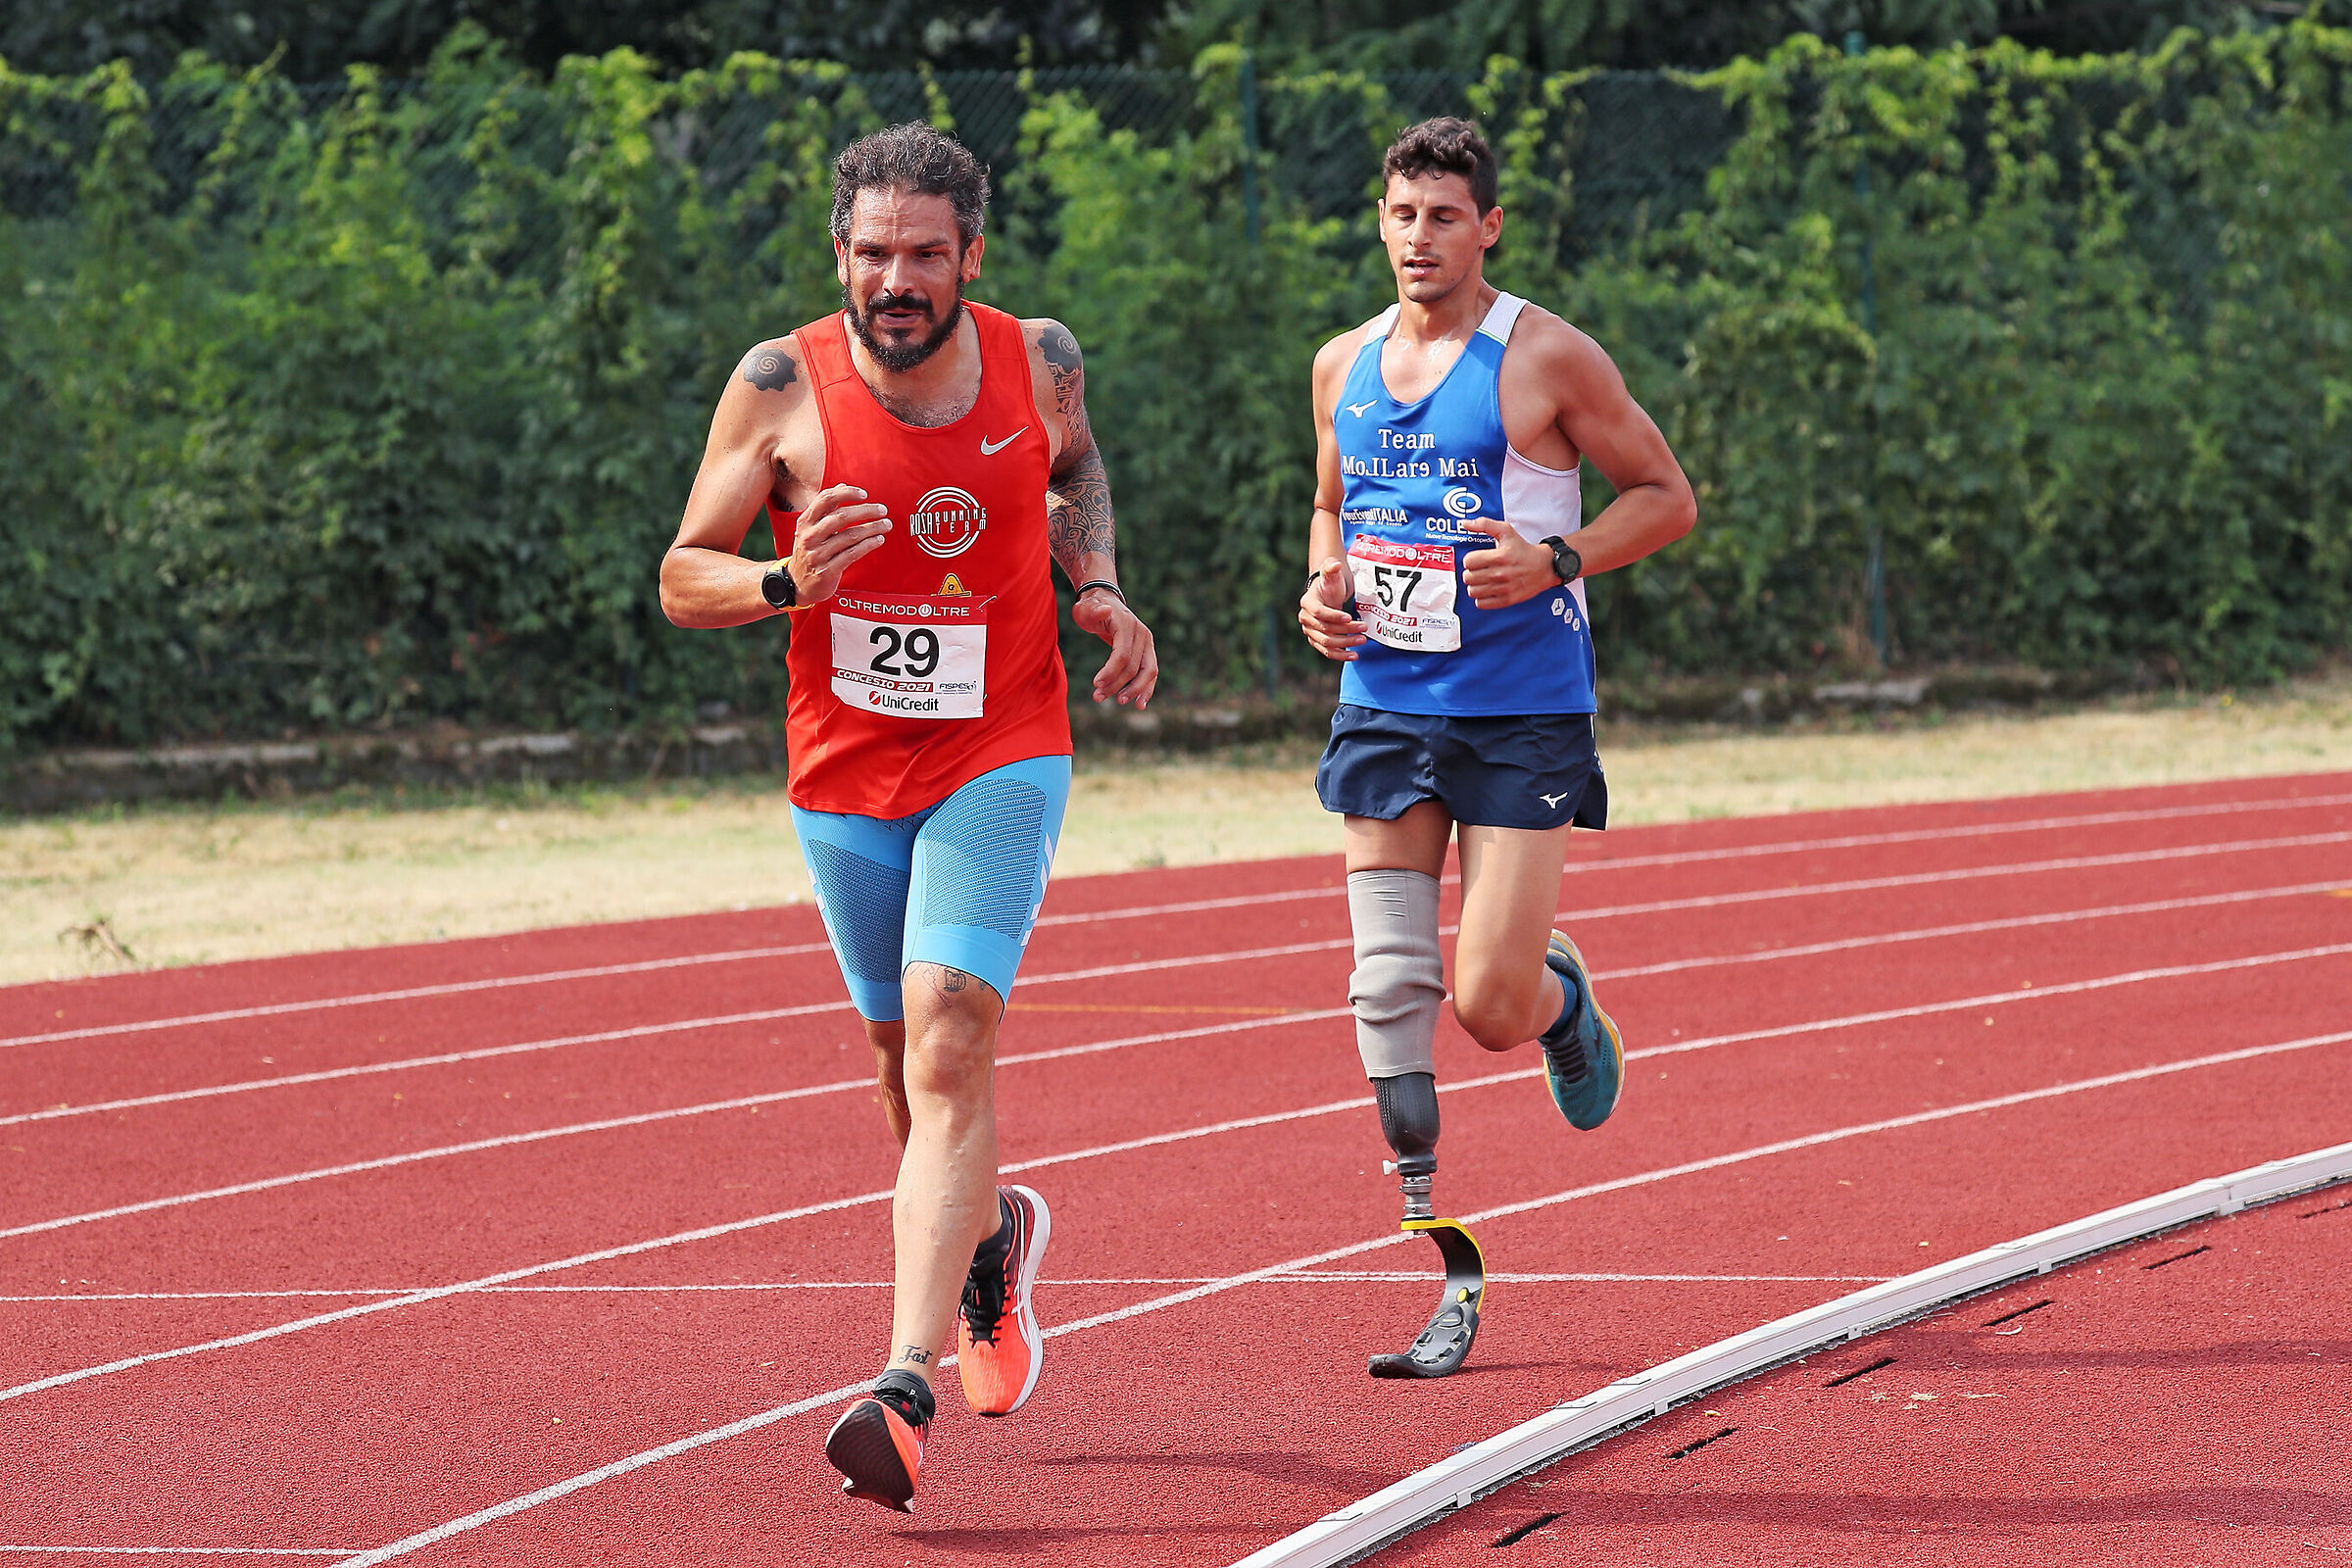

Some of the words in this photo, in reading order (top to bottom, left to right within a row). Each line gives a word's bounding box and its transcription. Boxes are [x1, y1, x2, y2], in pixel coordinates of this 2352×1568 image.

[1378, 428, 1436, 450] Team
[1439, 458, 1480, 478] Mai
[1374, 565, 1423, 612] 57
[838, 596, 971, 618] OLTREMODOLTRE
[1382, 625, 1423, 643] UniCredit
[868, 625, 941, 678] 29
[836, 669, 895, 689] CONCESIO
[896, 682, 933, 692] 2021
[881, 694, 940, 711] UniCredit
[898, 1345, 933, 1365] Fast
